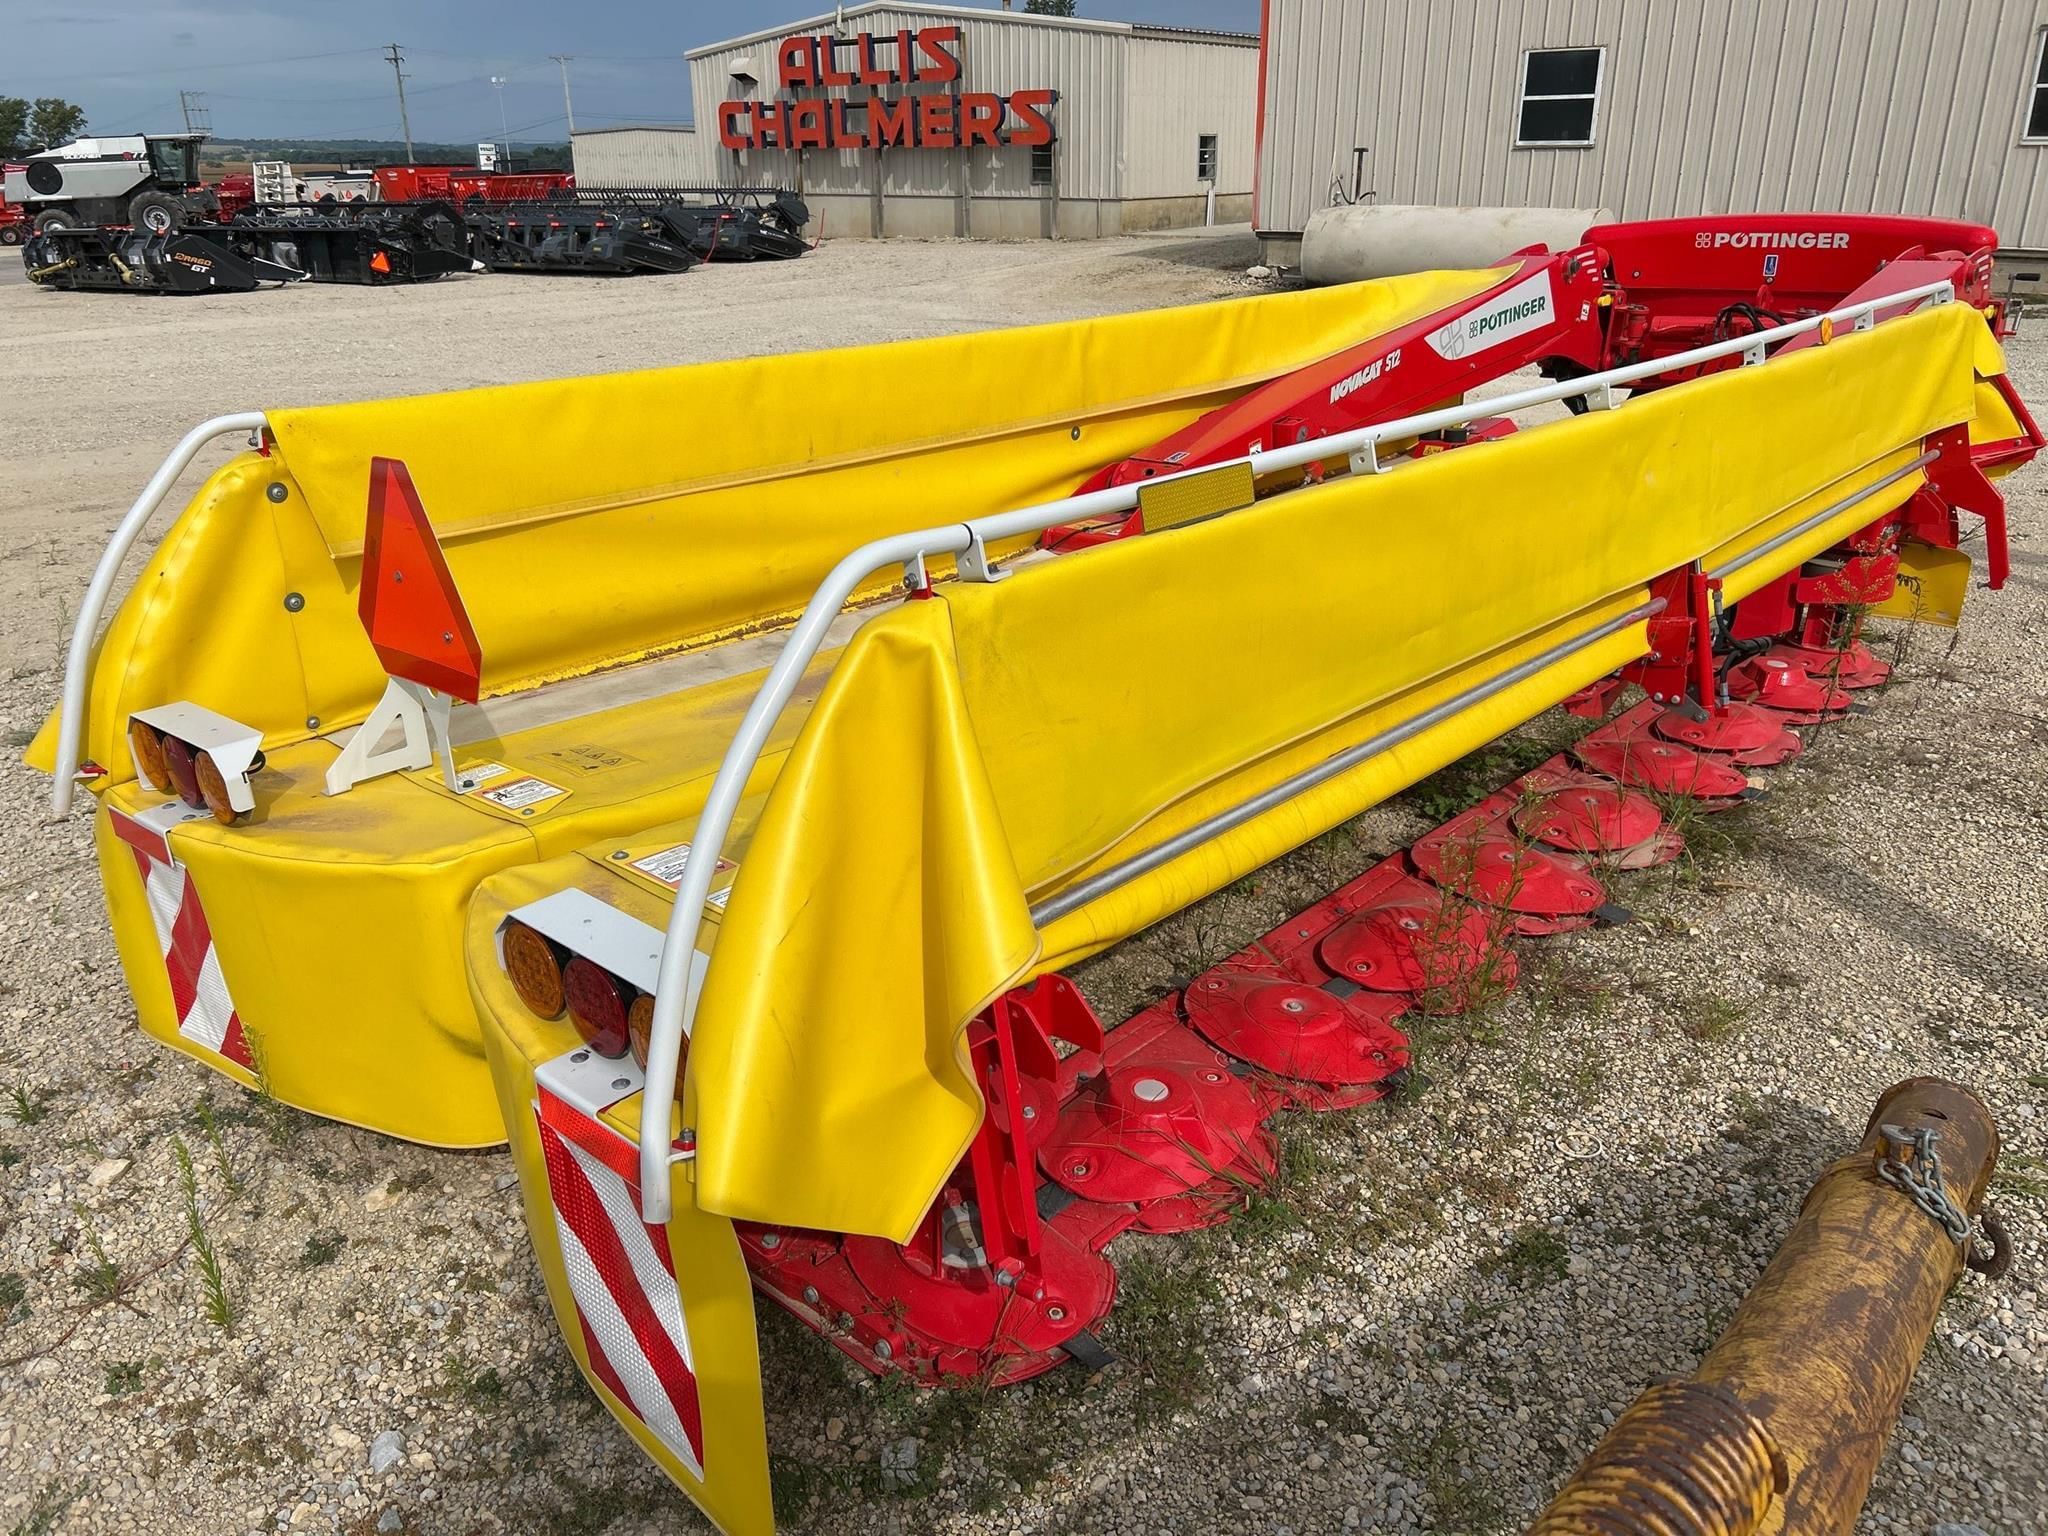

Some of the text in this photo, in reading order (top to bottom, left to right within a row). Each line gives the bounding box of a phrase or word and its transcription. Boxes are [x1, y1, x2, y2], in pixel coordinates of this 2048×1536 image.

[779, 26, 962, 88] ALLIS
[718, 89, 1057, 149] CHALMERS
[191, 264, 210, 273] GT
[1329, 358, 1384, 405] NOVACAT
